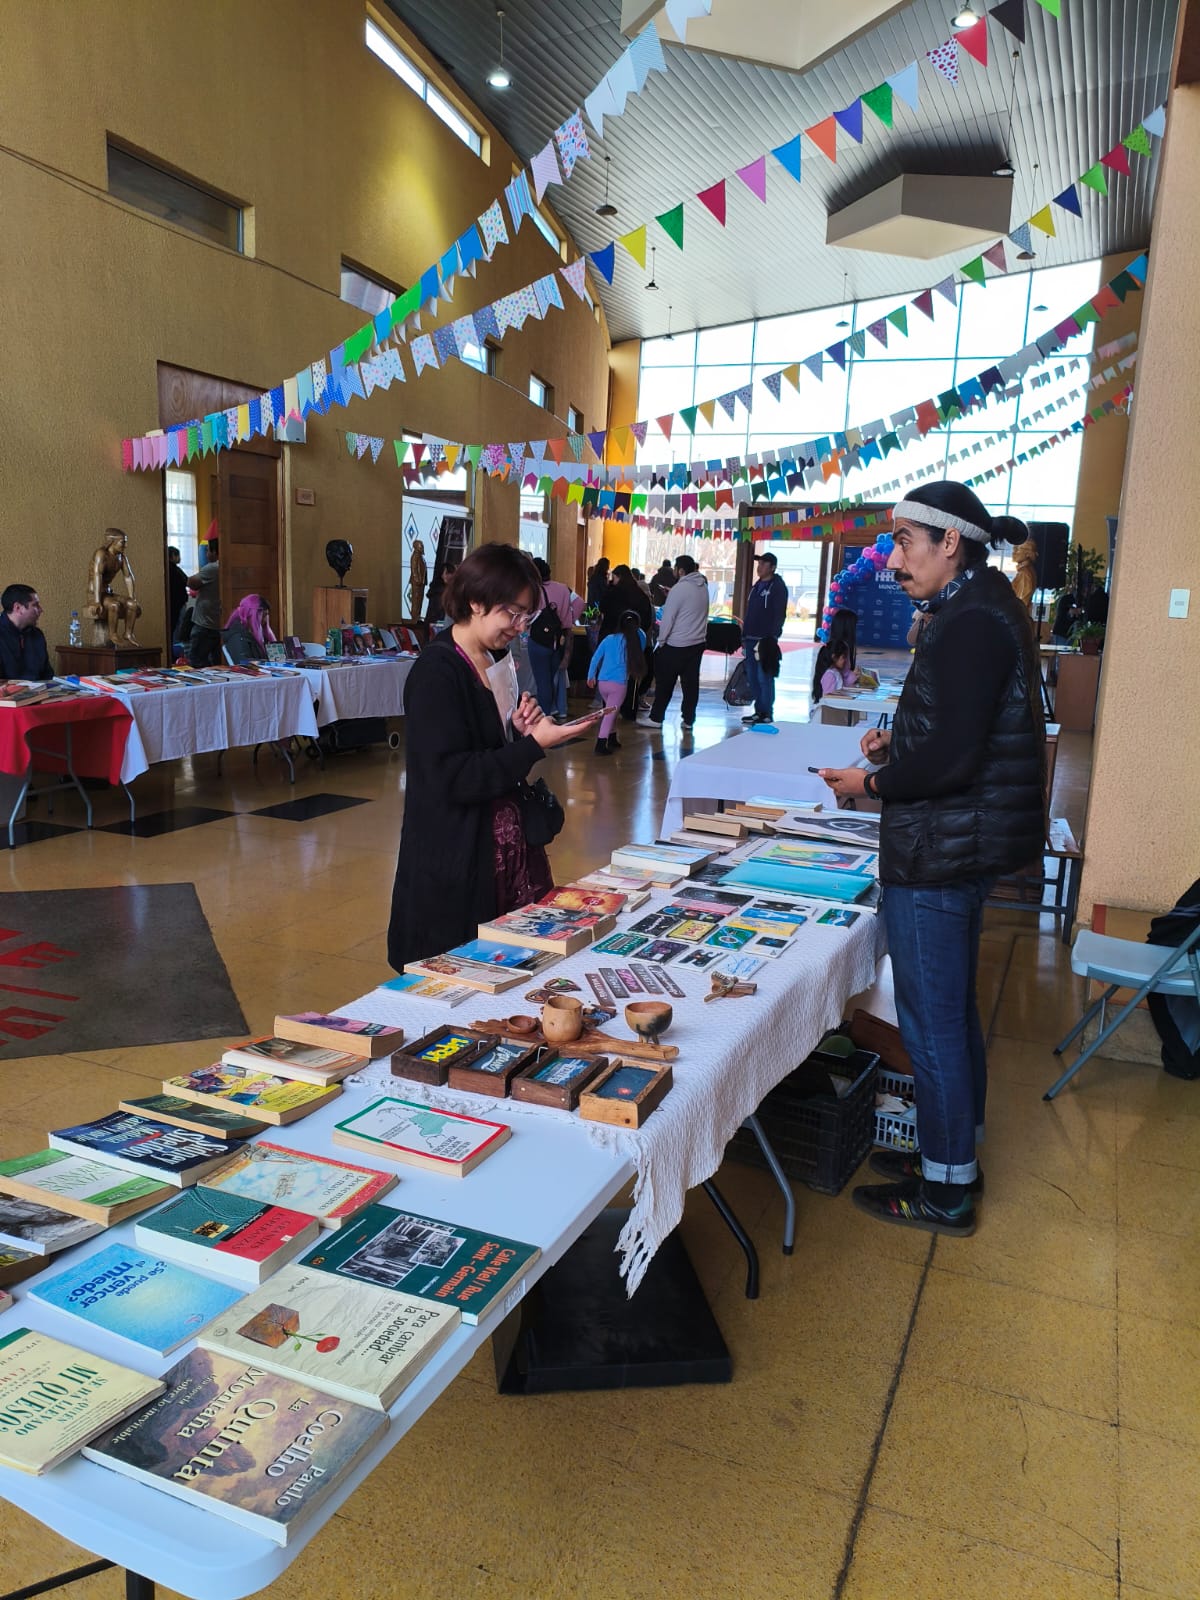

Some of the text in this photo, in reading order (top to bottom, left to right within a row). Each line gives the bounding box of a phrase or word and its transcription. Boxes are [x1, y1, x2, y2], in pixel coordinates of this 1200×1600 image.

[117, 1129, 206, 1159] Sheldon
[151, 1138, 229, 1165] Sidney
[472, 1241, 500, 1260] Saint
[490, 1248, 516, 1265] Calle
[66, 1262, 133, 1302] miedo?
[115, 1261, 167, 1297] ¿Se puede
[434, 1265, 476, 1298] Germain
[476, 1266, 501, 1282] Viel
[79, 1274, 135, 1308] vencer
[456, 1284, 482, 1301] Rue
[403, 1305, 422, 1314] la
[378, 1312, 440, 1365] Para cambiar
[58, 1363, 98, 1384] MI
[167, 1378, 192, 1399] sobre
[15, 1378, 107, 1435] SE HA LLEVADO
[177, 1366, 266, 1439] Montaña
[180, 1385, 203, 1405] novela
[288, 1397, 311, 1412] La
[59, 1398, 88, 1423] ¿QUIÉN
[112, 1406, 155, 1444] inevitable
[174, 1398, 277, 1482] Quinta
[265, 1409, 343, 1478] Coelho
[276, 1465, 326, 1507] Paulo
